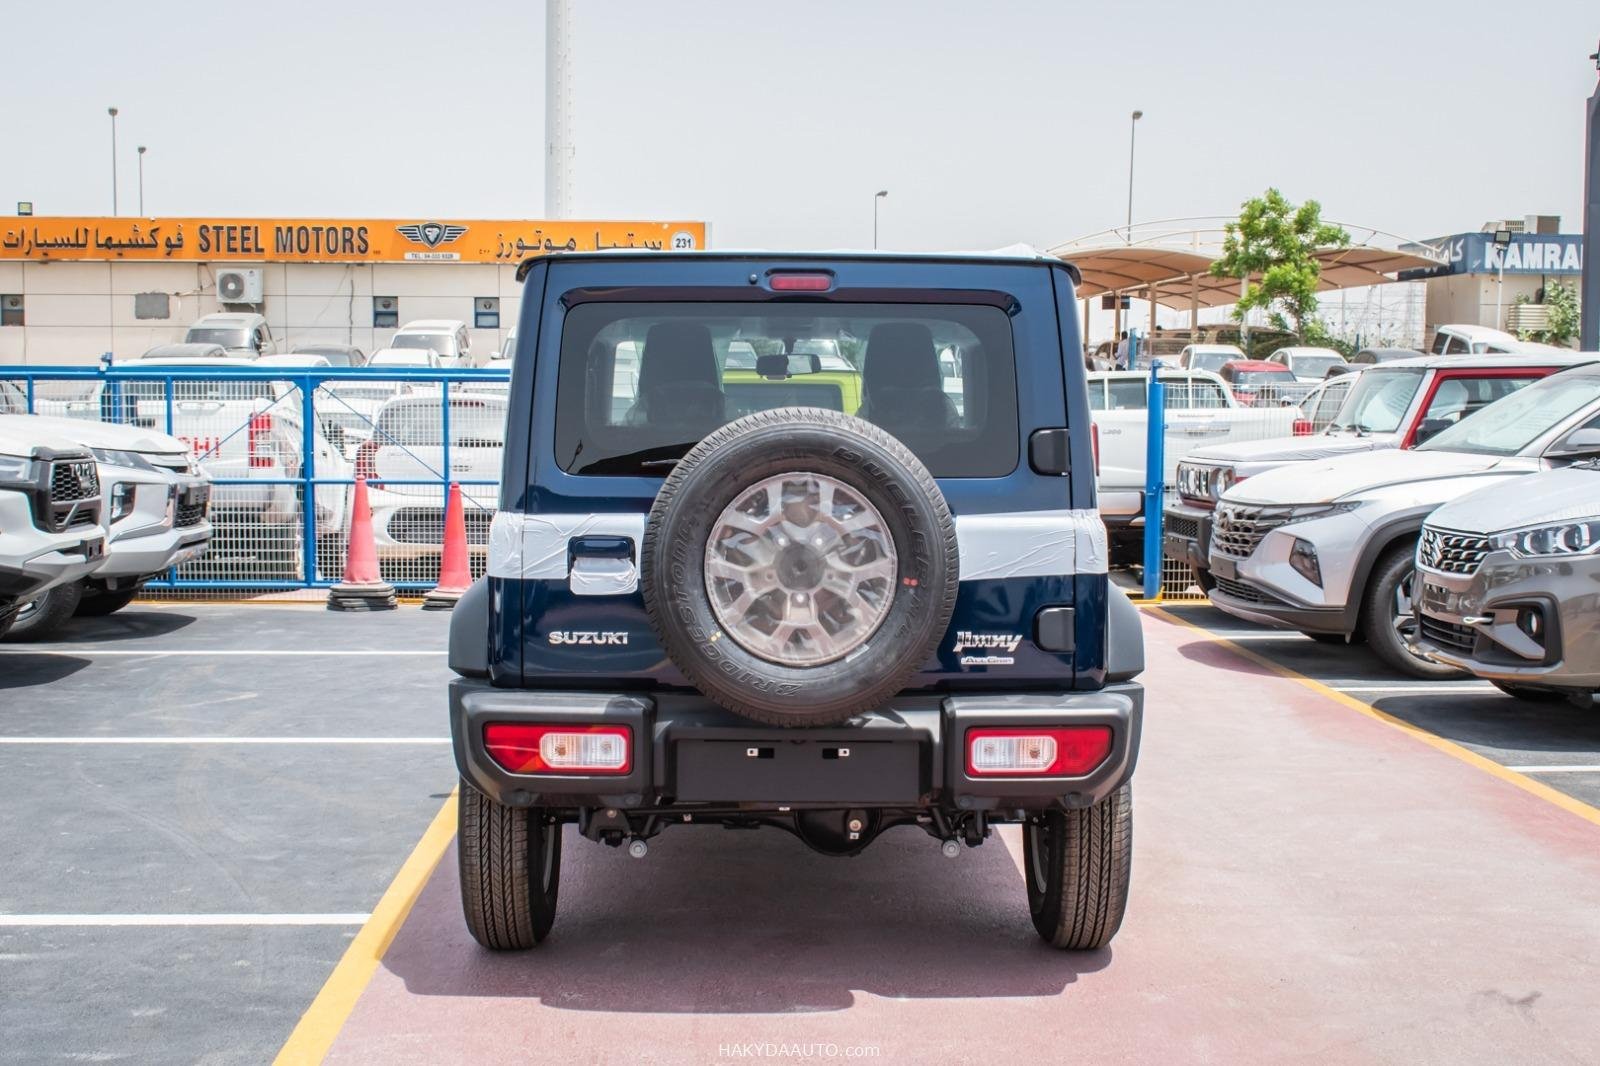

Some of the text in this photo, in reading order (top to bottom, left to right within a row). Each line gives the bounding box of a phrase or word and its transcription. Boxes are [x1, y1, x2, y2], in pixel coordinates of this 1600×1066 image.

[198, 225, 370, 255] STEEL MOTORS
[675, 237, 692, 249] 231
[1484, 242, 1583, 270] KAMRA
[549, 631, 628, 644] SUZUKI
